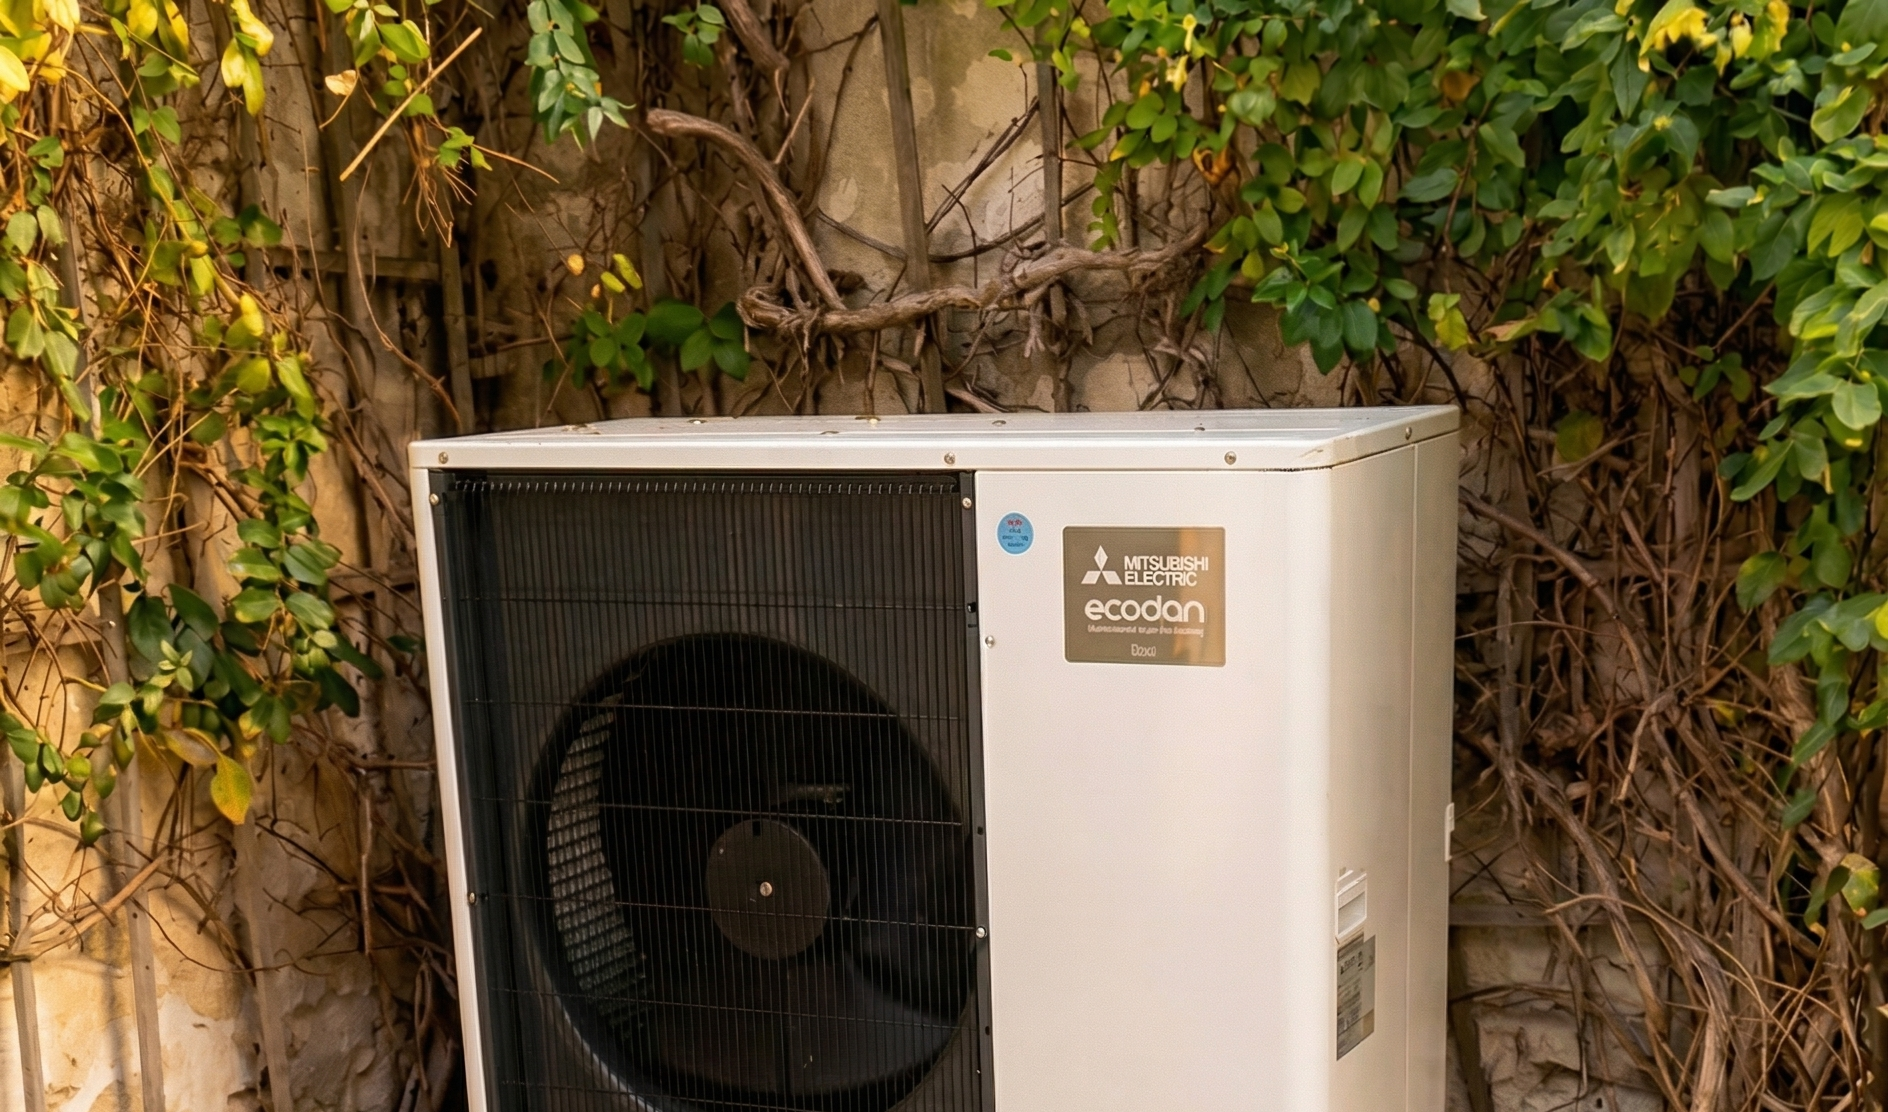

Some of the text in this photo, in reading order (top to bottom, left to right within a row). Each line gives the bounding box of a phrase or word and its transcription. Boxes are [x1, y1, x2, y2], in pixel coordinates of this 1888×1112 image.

[1124, 555, 1209, 571] MITSUBISHI
[1124, 571, 1197, 586] ELECTRIC
[1084, 595, 1205, 623] ecodan
